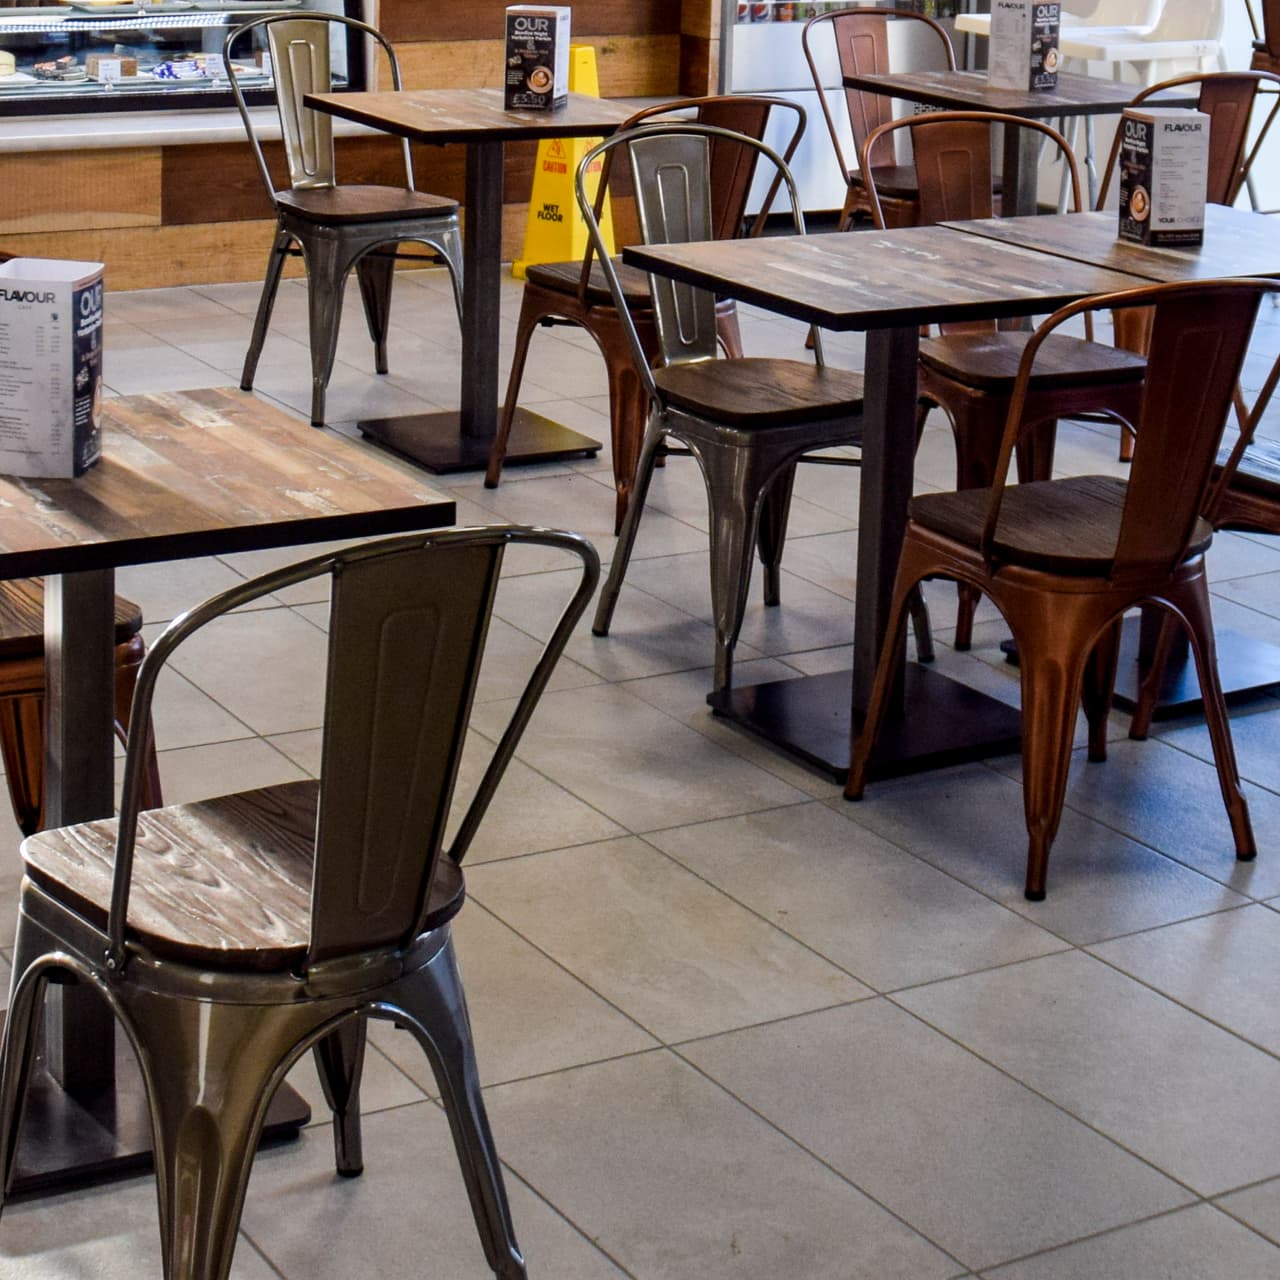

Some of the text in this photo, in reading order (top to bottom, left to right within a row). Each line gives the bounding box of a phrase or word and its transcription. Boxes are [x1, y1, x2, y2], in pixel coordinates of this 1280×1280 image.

[1037, 5, 1058, 17] OUR
[515, 17, 548, 31] OUR
[1125, 121, 1147, 140] OUR
[1164, 123, 1202, 133] FLAVOUR
[543, 203, 559, 213] WET
[537, 211, 563, 222] FLOOR
